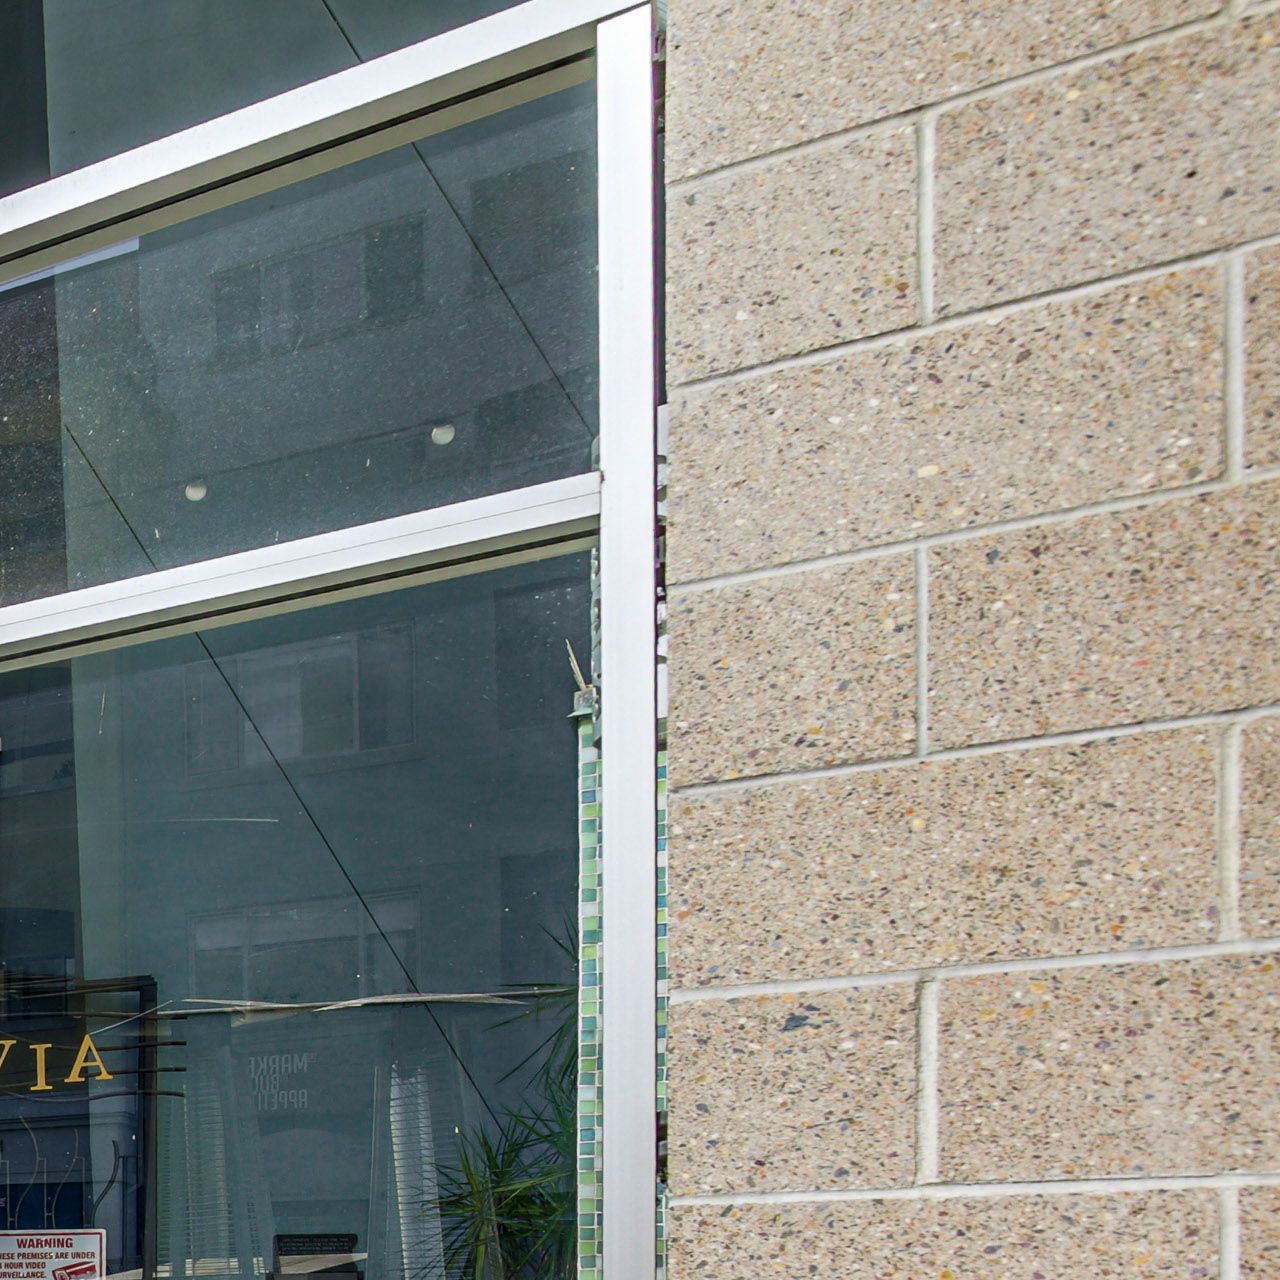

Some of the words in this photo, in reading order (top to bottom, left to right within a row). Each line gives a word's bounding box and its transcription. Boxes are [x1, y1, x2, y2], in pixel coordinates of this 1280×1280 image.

[16, 1237, 74, 1249] WARNING
[17, 1252, 53, 1260] PREMISES
[71, 1251, 96, 1259] UNDER
